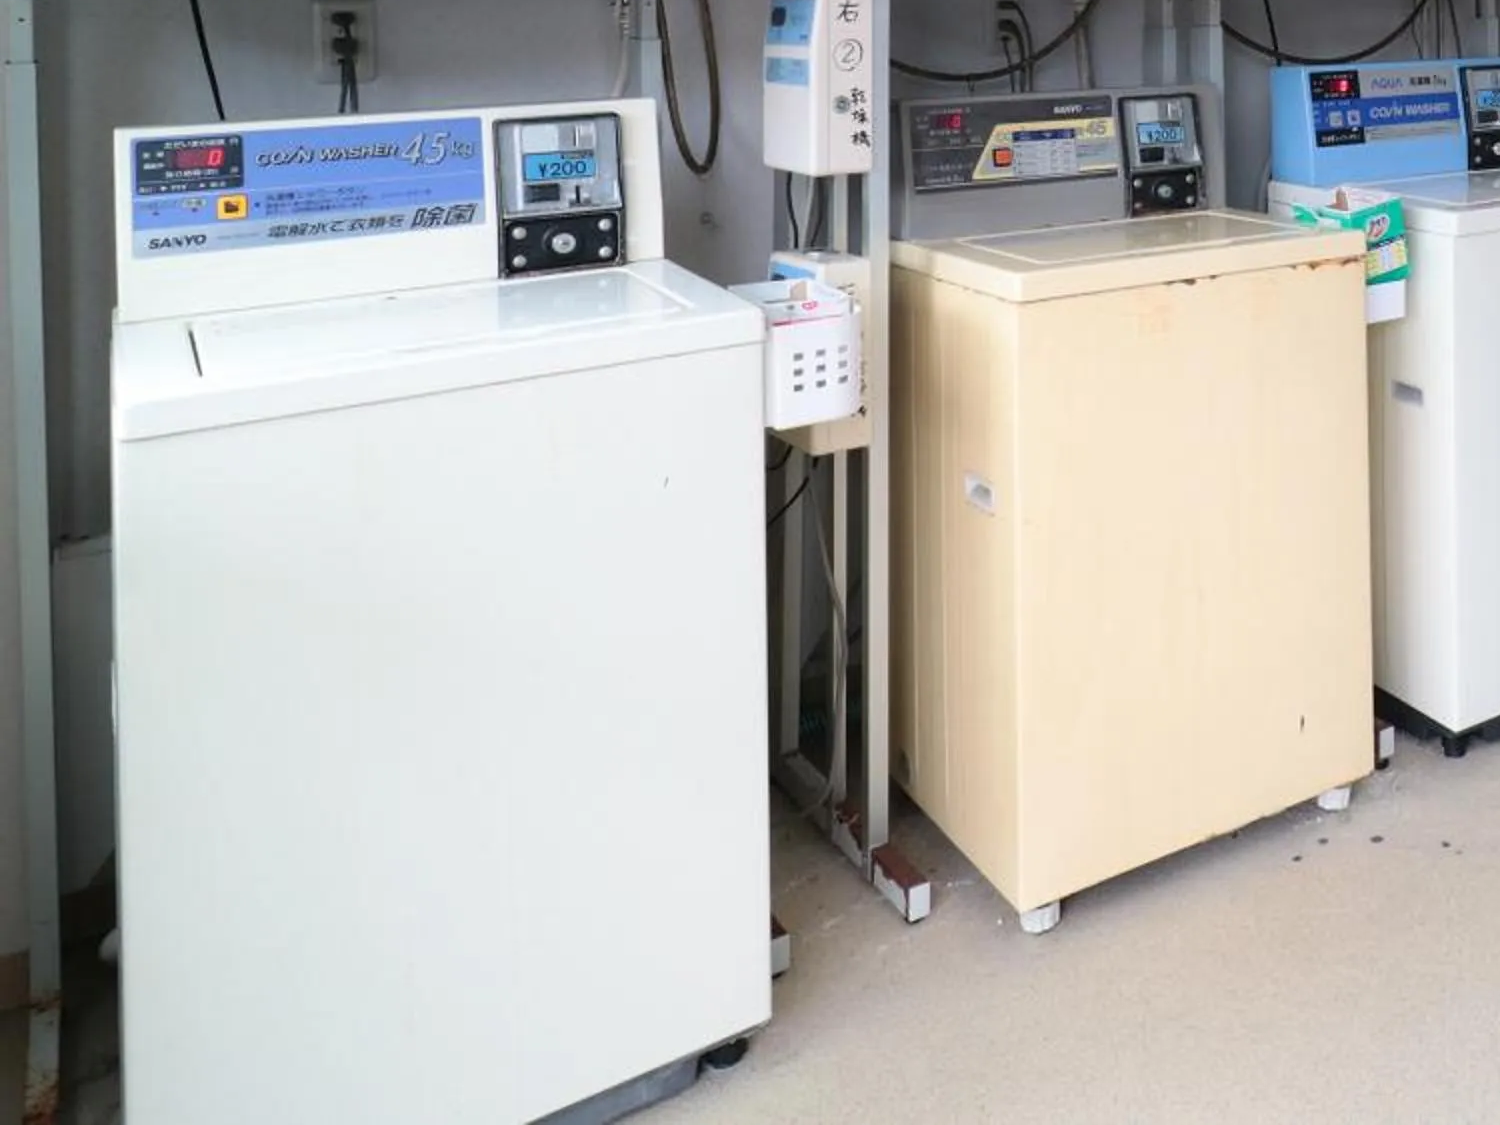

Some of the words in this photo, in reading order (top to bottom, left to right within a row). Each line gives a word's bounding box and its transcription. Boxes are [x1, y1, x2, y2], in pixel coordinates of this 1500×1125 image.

[837, 0, 861, 24] 右
[256, 145, 313, 167] COIN
[318, 141, 400, 162] WASHER
[538, 160, 587, 178] ¥200
[411, 202, 479, 229] 除菌
[148, 234, 207, 250] SANYO
